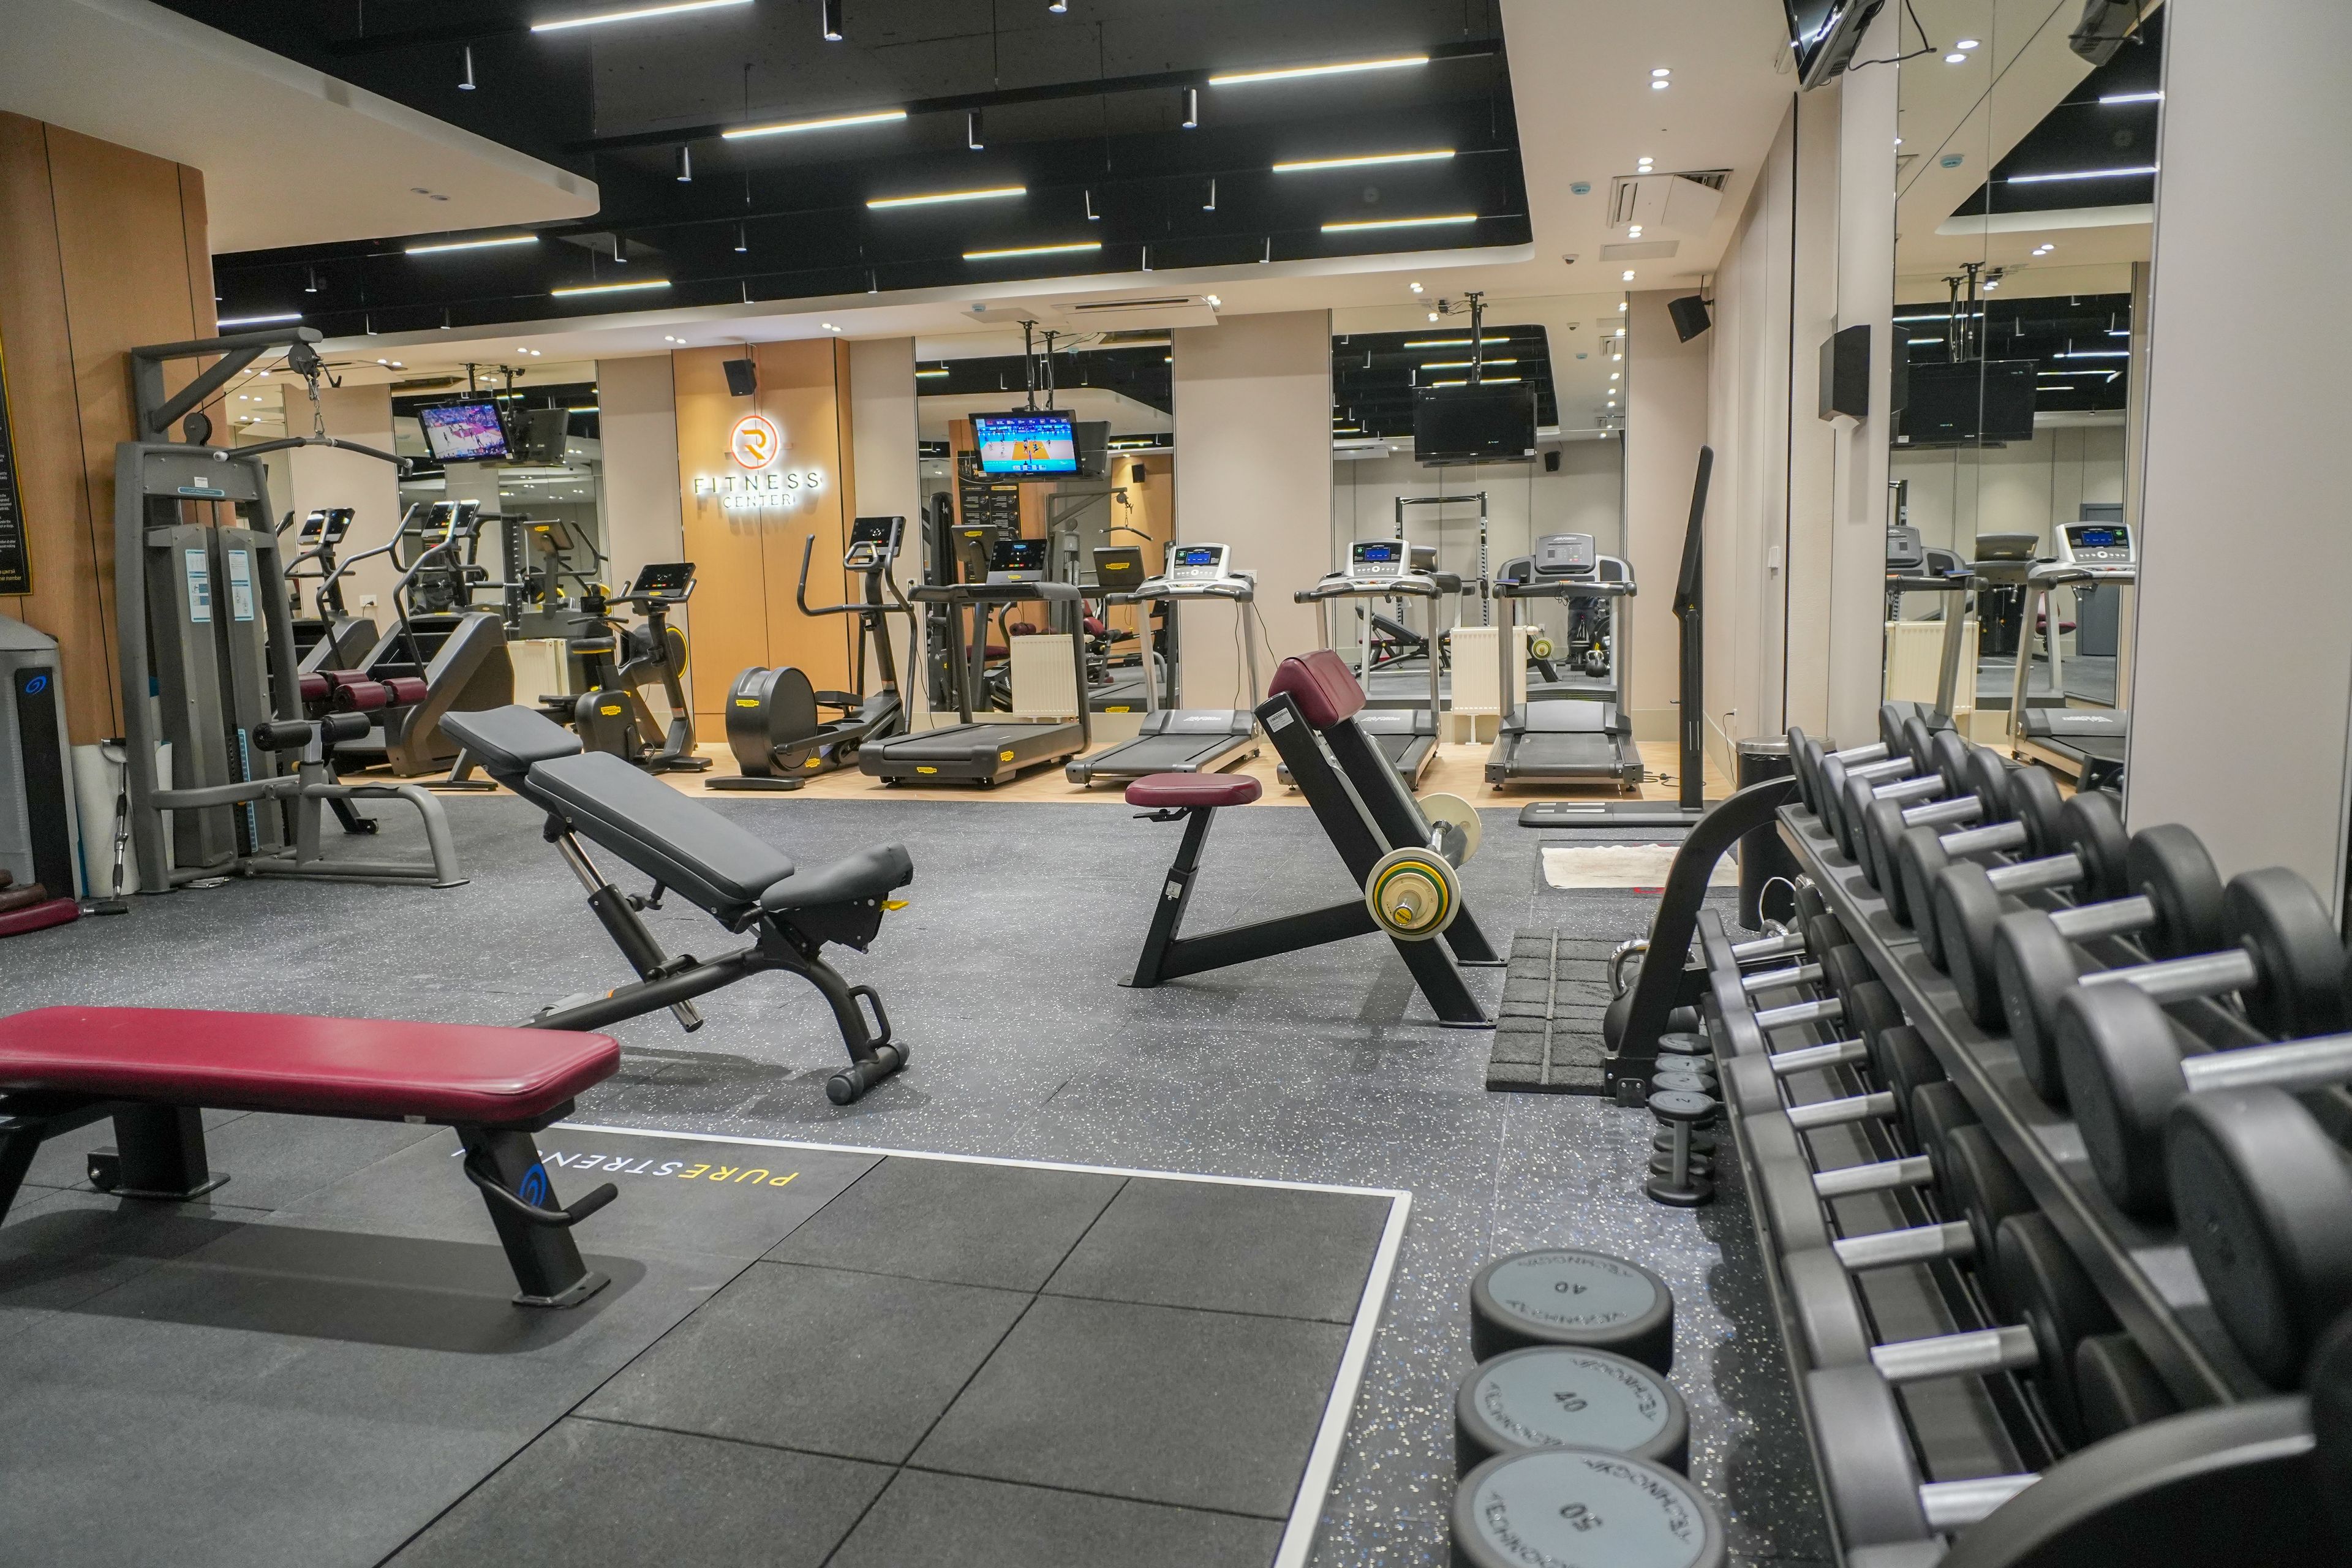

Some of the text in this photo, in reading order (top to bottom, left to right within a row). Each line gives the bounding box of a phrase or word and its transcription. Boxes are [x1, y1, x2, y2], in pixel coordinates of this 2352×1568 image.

[694, 472, 819, 494] FITNESS
[723, 494, 791, 508] CENTER
[1555, 1281, 1588, 1295] 40
[1553, 1391, 1588, 1412] 40
[1559, 1501, 1604, 1532] 50
